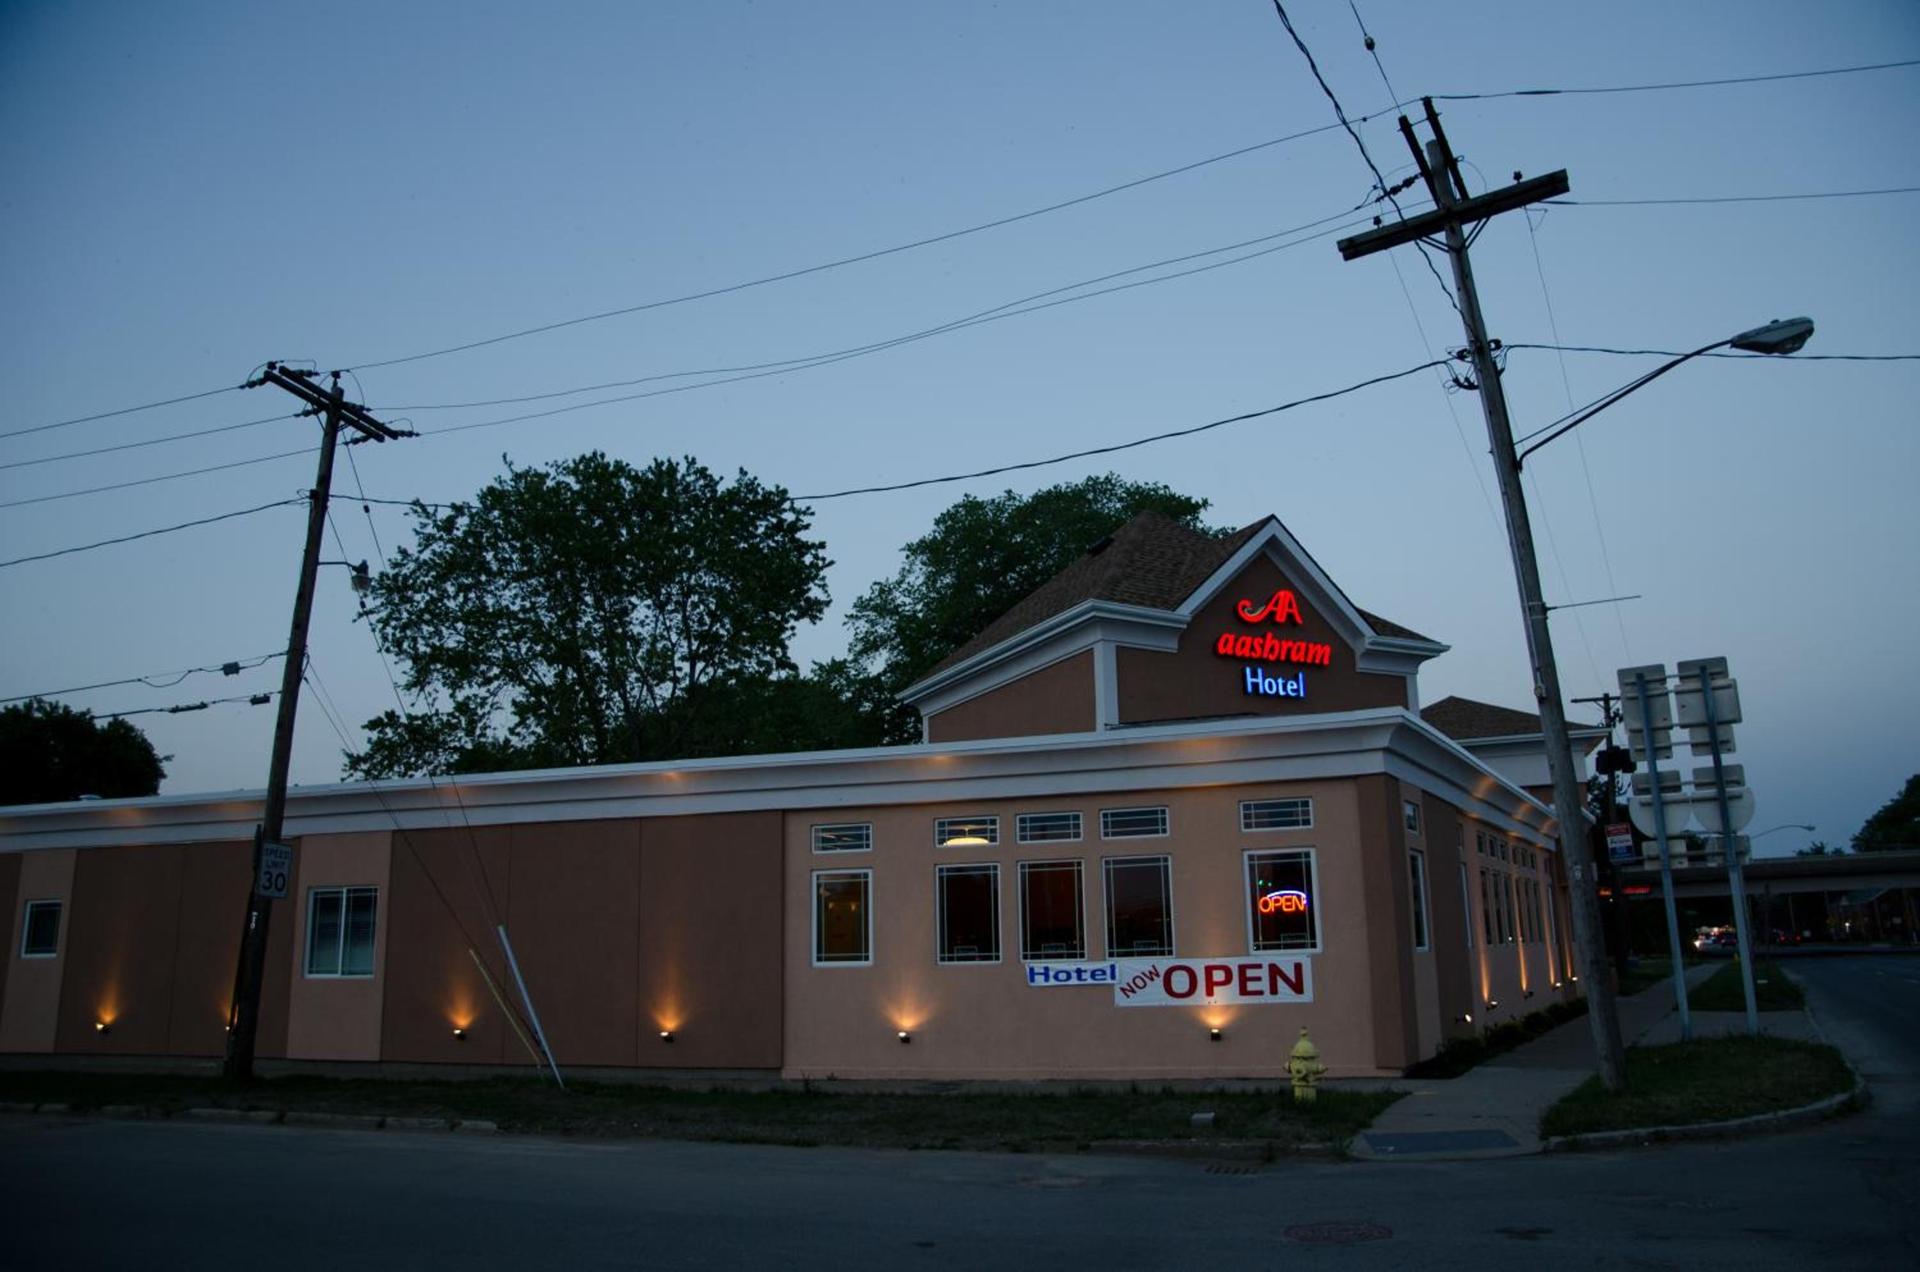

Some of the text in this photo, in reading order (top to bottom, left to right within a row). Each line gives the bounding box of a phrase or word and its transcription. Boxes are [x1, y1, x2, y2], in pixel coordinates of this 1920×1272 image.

[1245, 666, 1305, 698] Hotel
[264, 847, 289, 859] SPEED
[265, 859, 285, 868] LIMIT
[262, 870, 286, 892] 30
[1259, 895, 1305, 913] OPEN
[1028, 964, 1117, 984] Hotel
[1119, 962, 1304, 999] NOW OPEN
